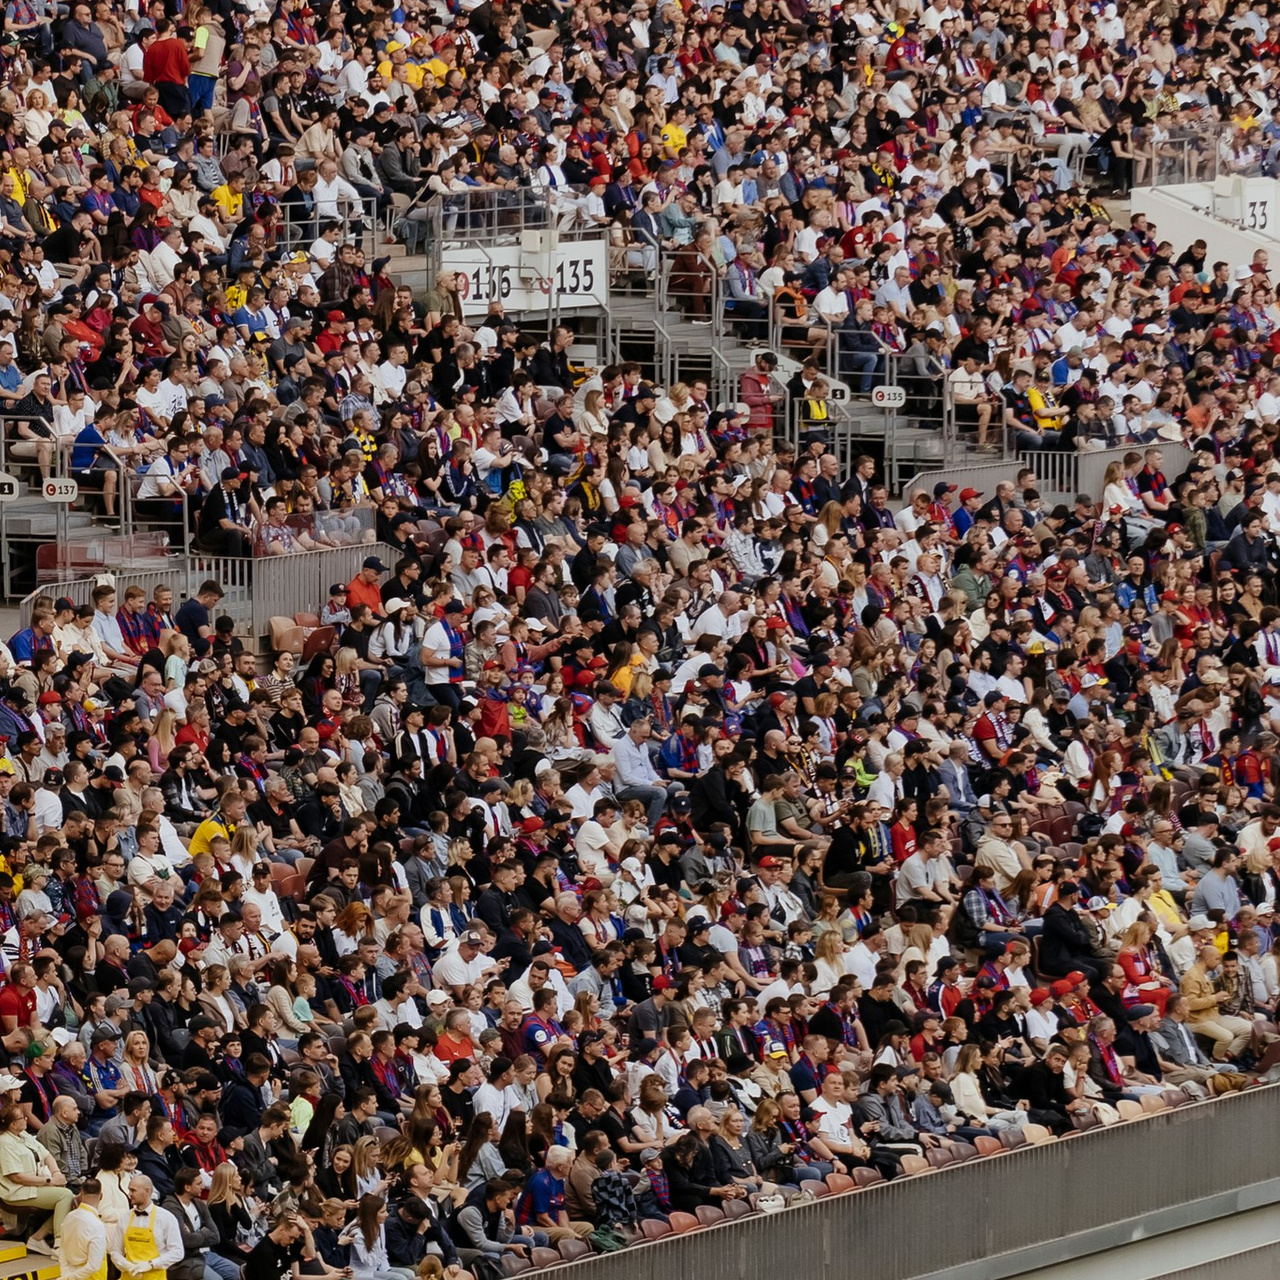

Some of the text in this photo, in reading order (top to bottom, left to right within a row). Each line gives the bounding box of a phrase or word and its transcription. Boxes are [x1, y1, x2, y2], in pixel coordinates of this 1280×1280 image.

[556, 260, 594, 294] 135
[887, 392, 902, 401] 135
[58, 485, 75, 494] 137
